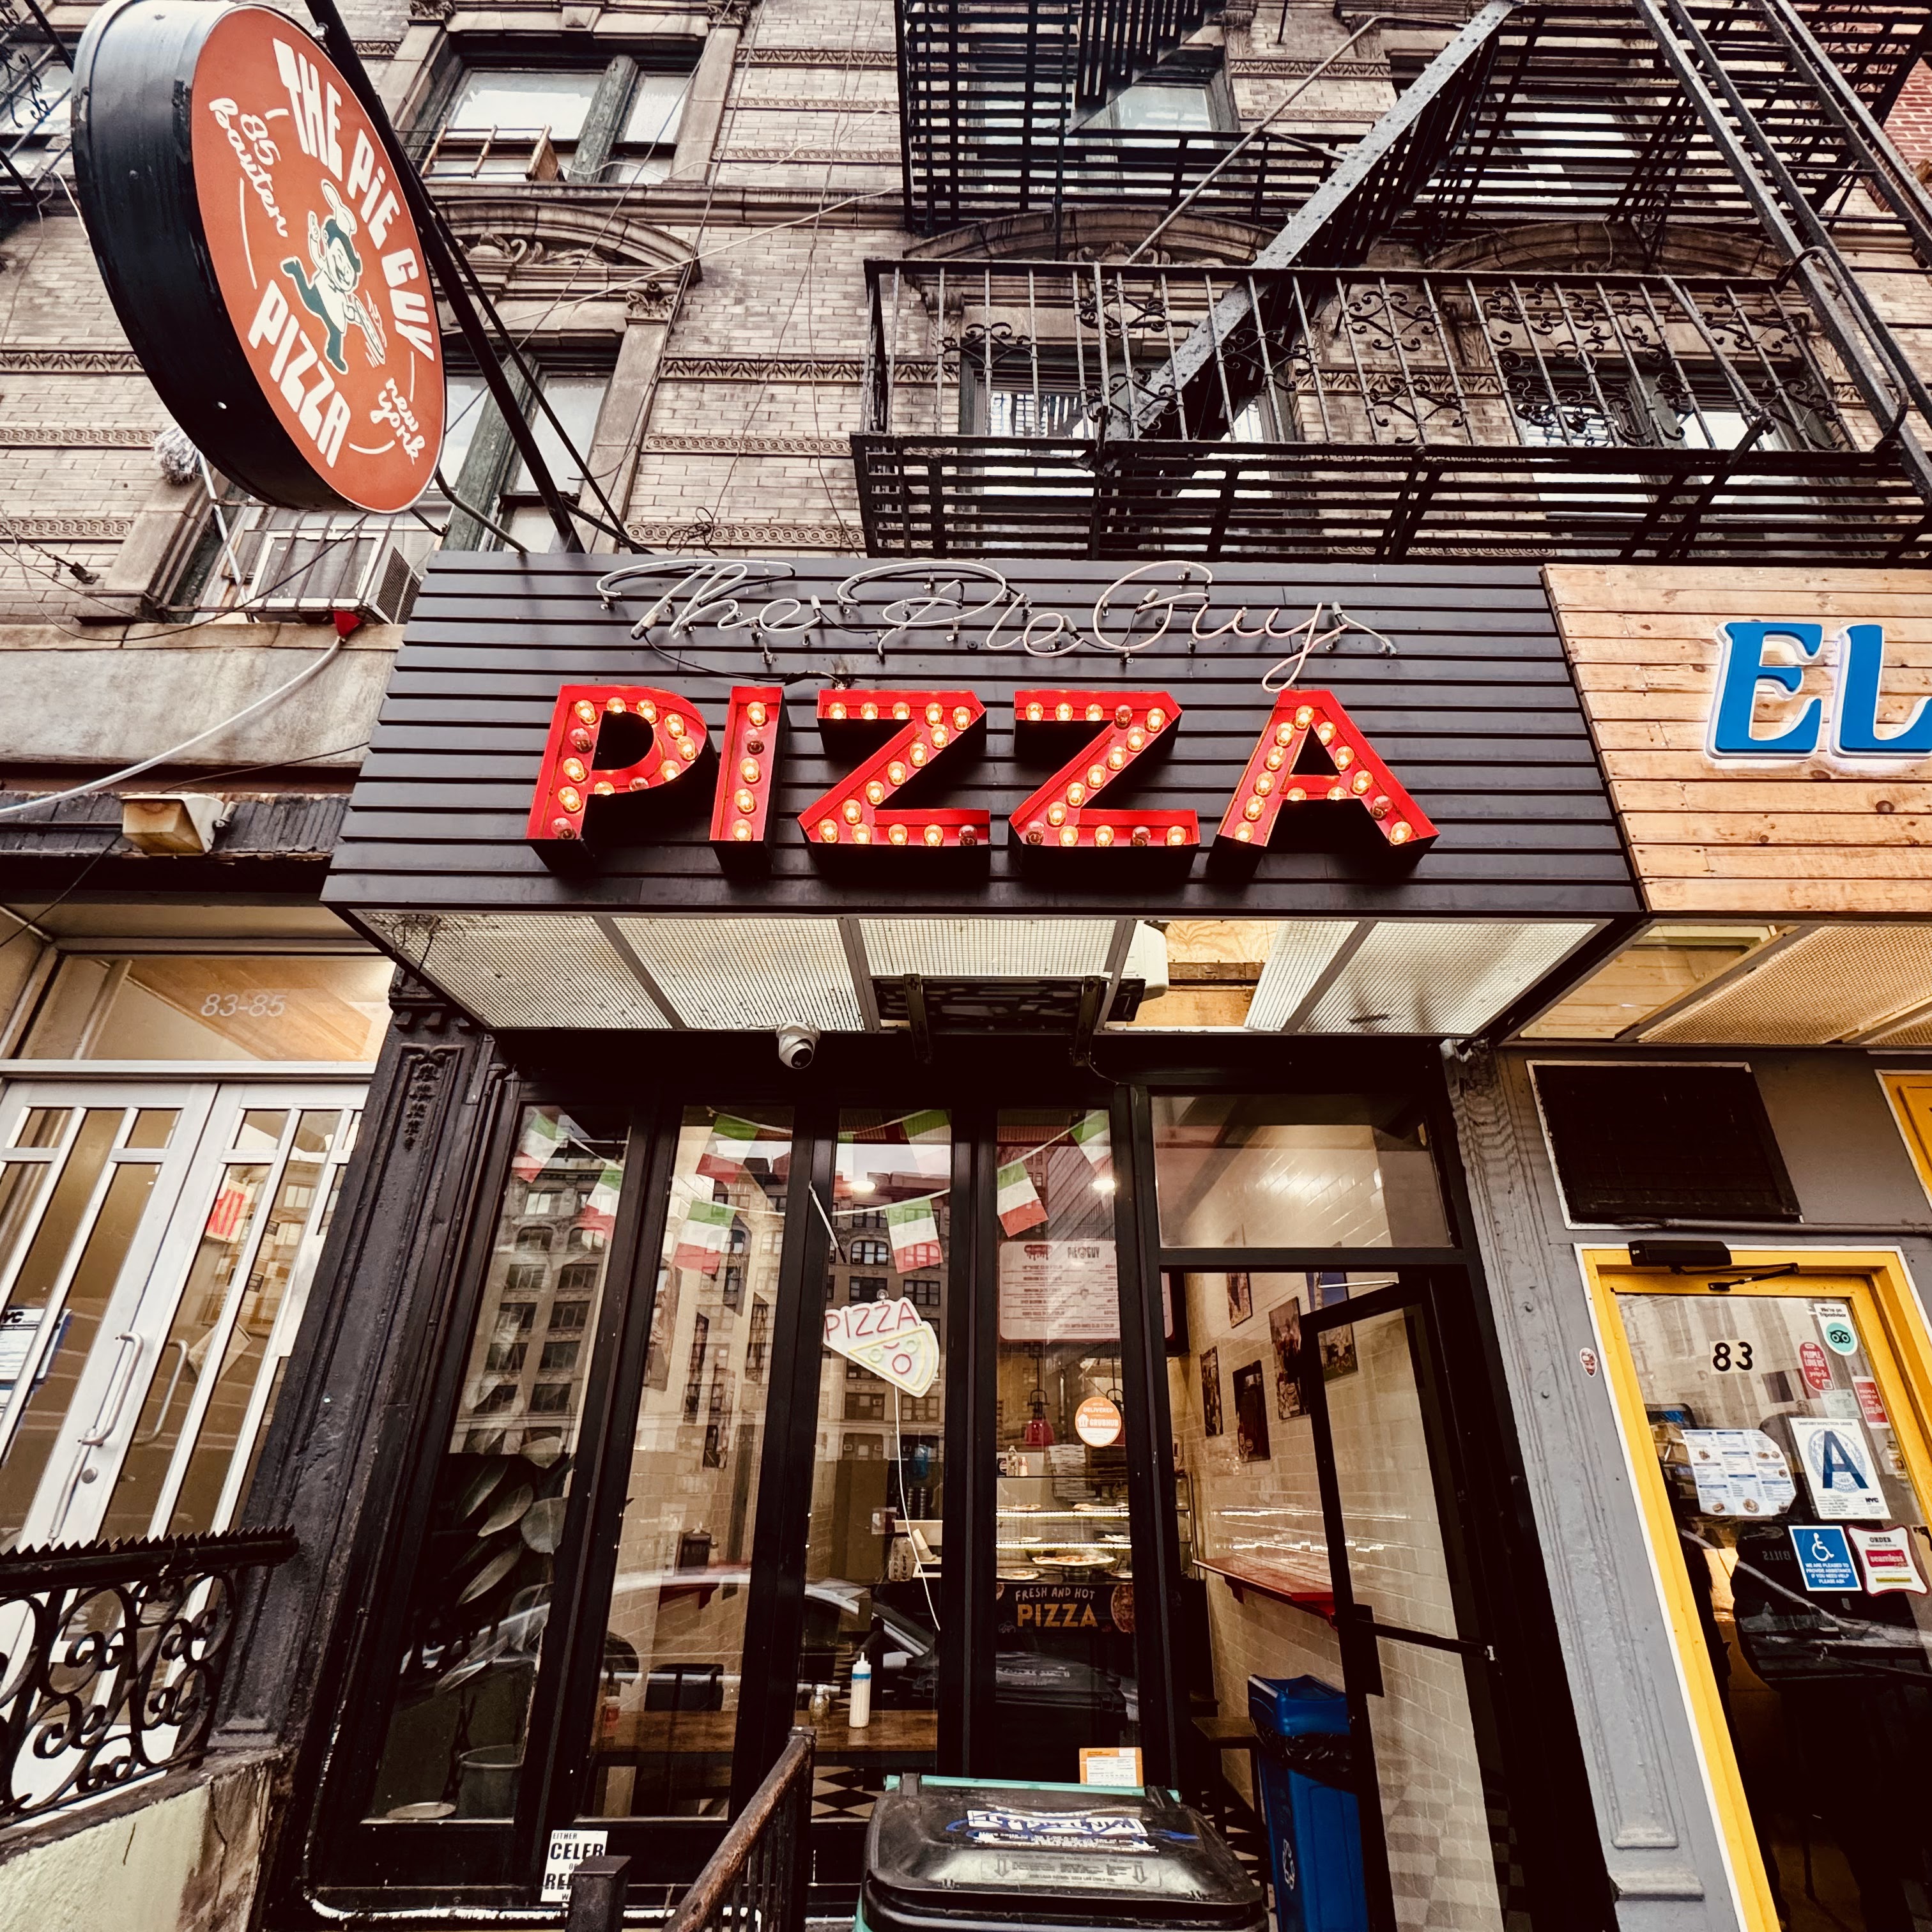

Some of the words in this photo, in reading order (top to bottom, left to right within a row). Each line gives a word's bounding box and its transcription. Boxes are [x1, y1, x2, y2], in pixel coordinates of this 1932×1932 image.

[240, 114, 281, 165] 85
[273, 38, 342, 181] THE
[382, 248, 434, 361] GUY
[248, 280, 351, 468] PIZZA
[370, 390, 425, 465] york
[385, 378, 420, 432] new
[596, 558, 822, 640] The
[836, 561, 1084, 657] Pie
[1706, 621, 1932, 759] EL
[525, 684, 1441, 862] PIZZA
[201, 993, 287, 1017] 83-85
[3, 1310, 24, 1324] YC
[824, 1301, 918, 1341] PIZZA
[1713, 1342, 1753, 1372] 83
[1089, 1418, 1119, 1427] GRUBHUB
[1822, 1430, 1869, 1489] A
[1015, 1587, 1048, 1601] FRESH
[1051, 1587, 1071, 1598] AND
[1075, 1588, 1096, 1600] HOT
[1016, 1603, 1098, 1627] PIZZA
